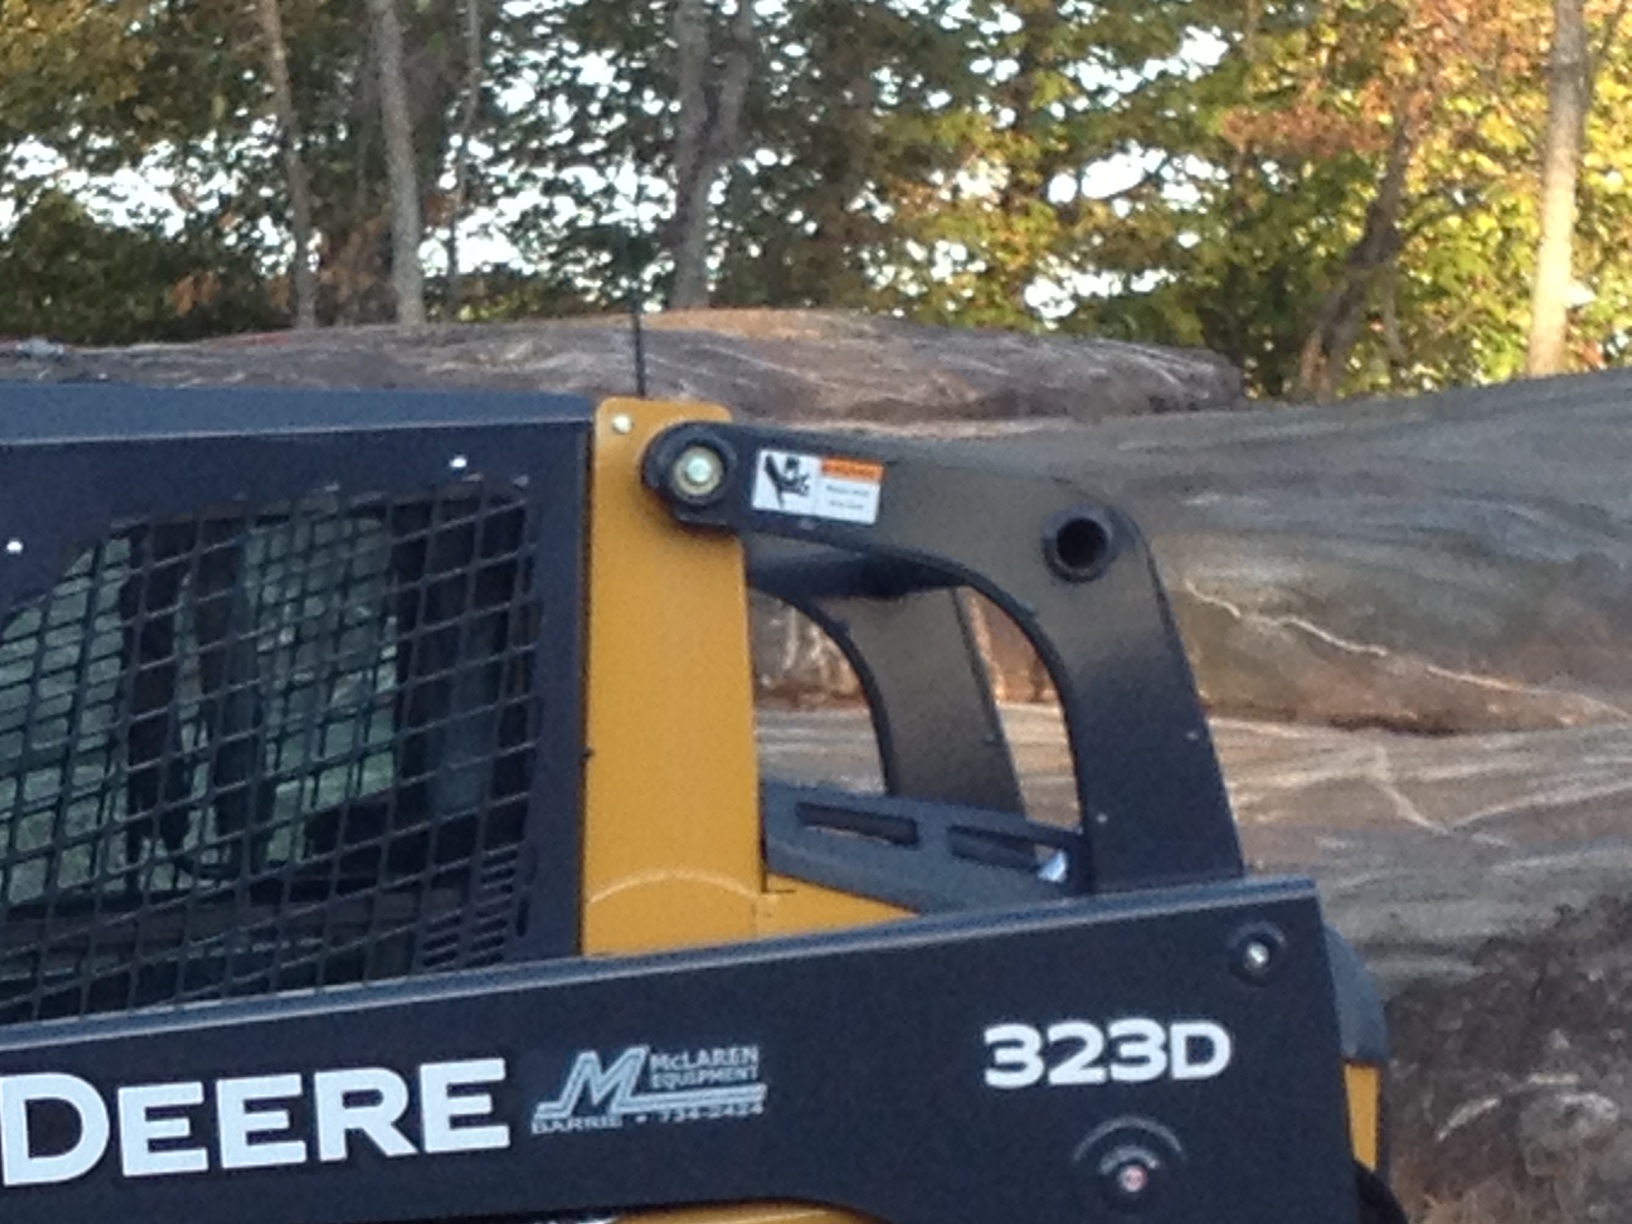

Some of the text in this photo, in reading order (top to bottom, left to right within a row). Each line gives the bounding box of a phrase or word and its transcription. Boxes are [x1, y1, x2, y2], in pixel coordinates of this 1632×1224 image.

[649, 1045, 760, 1072] McLAREN
[983, 1017, 1233, 1089] 323D
[650, 1064, 759, 1089] EQUIPMENT
[530, 1114, 624, 1135] BARRIE
